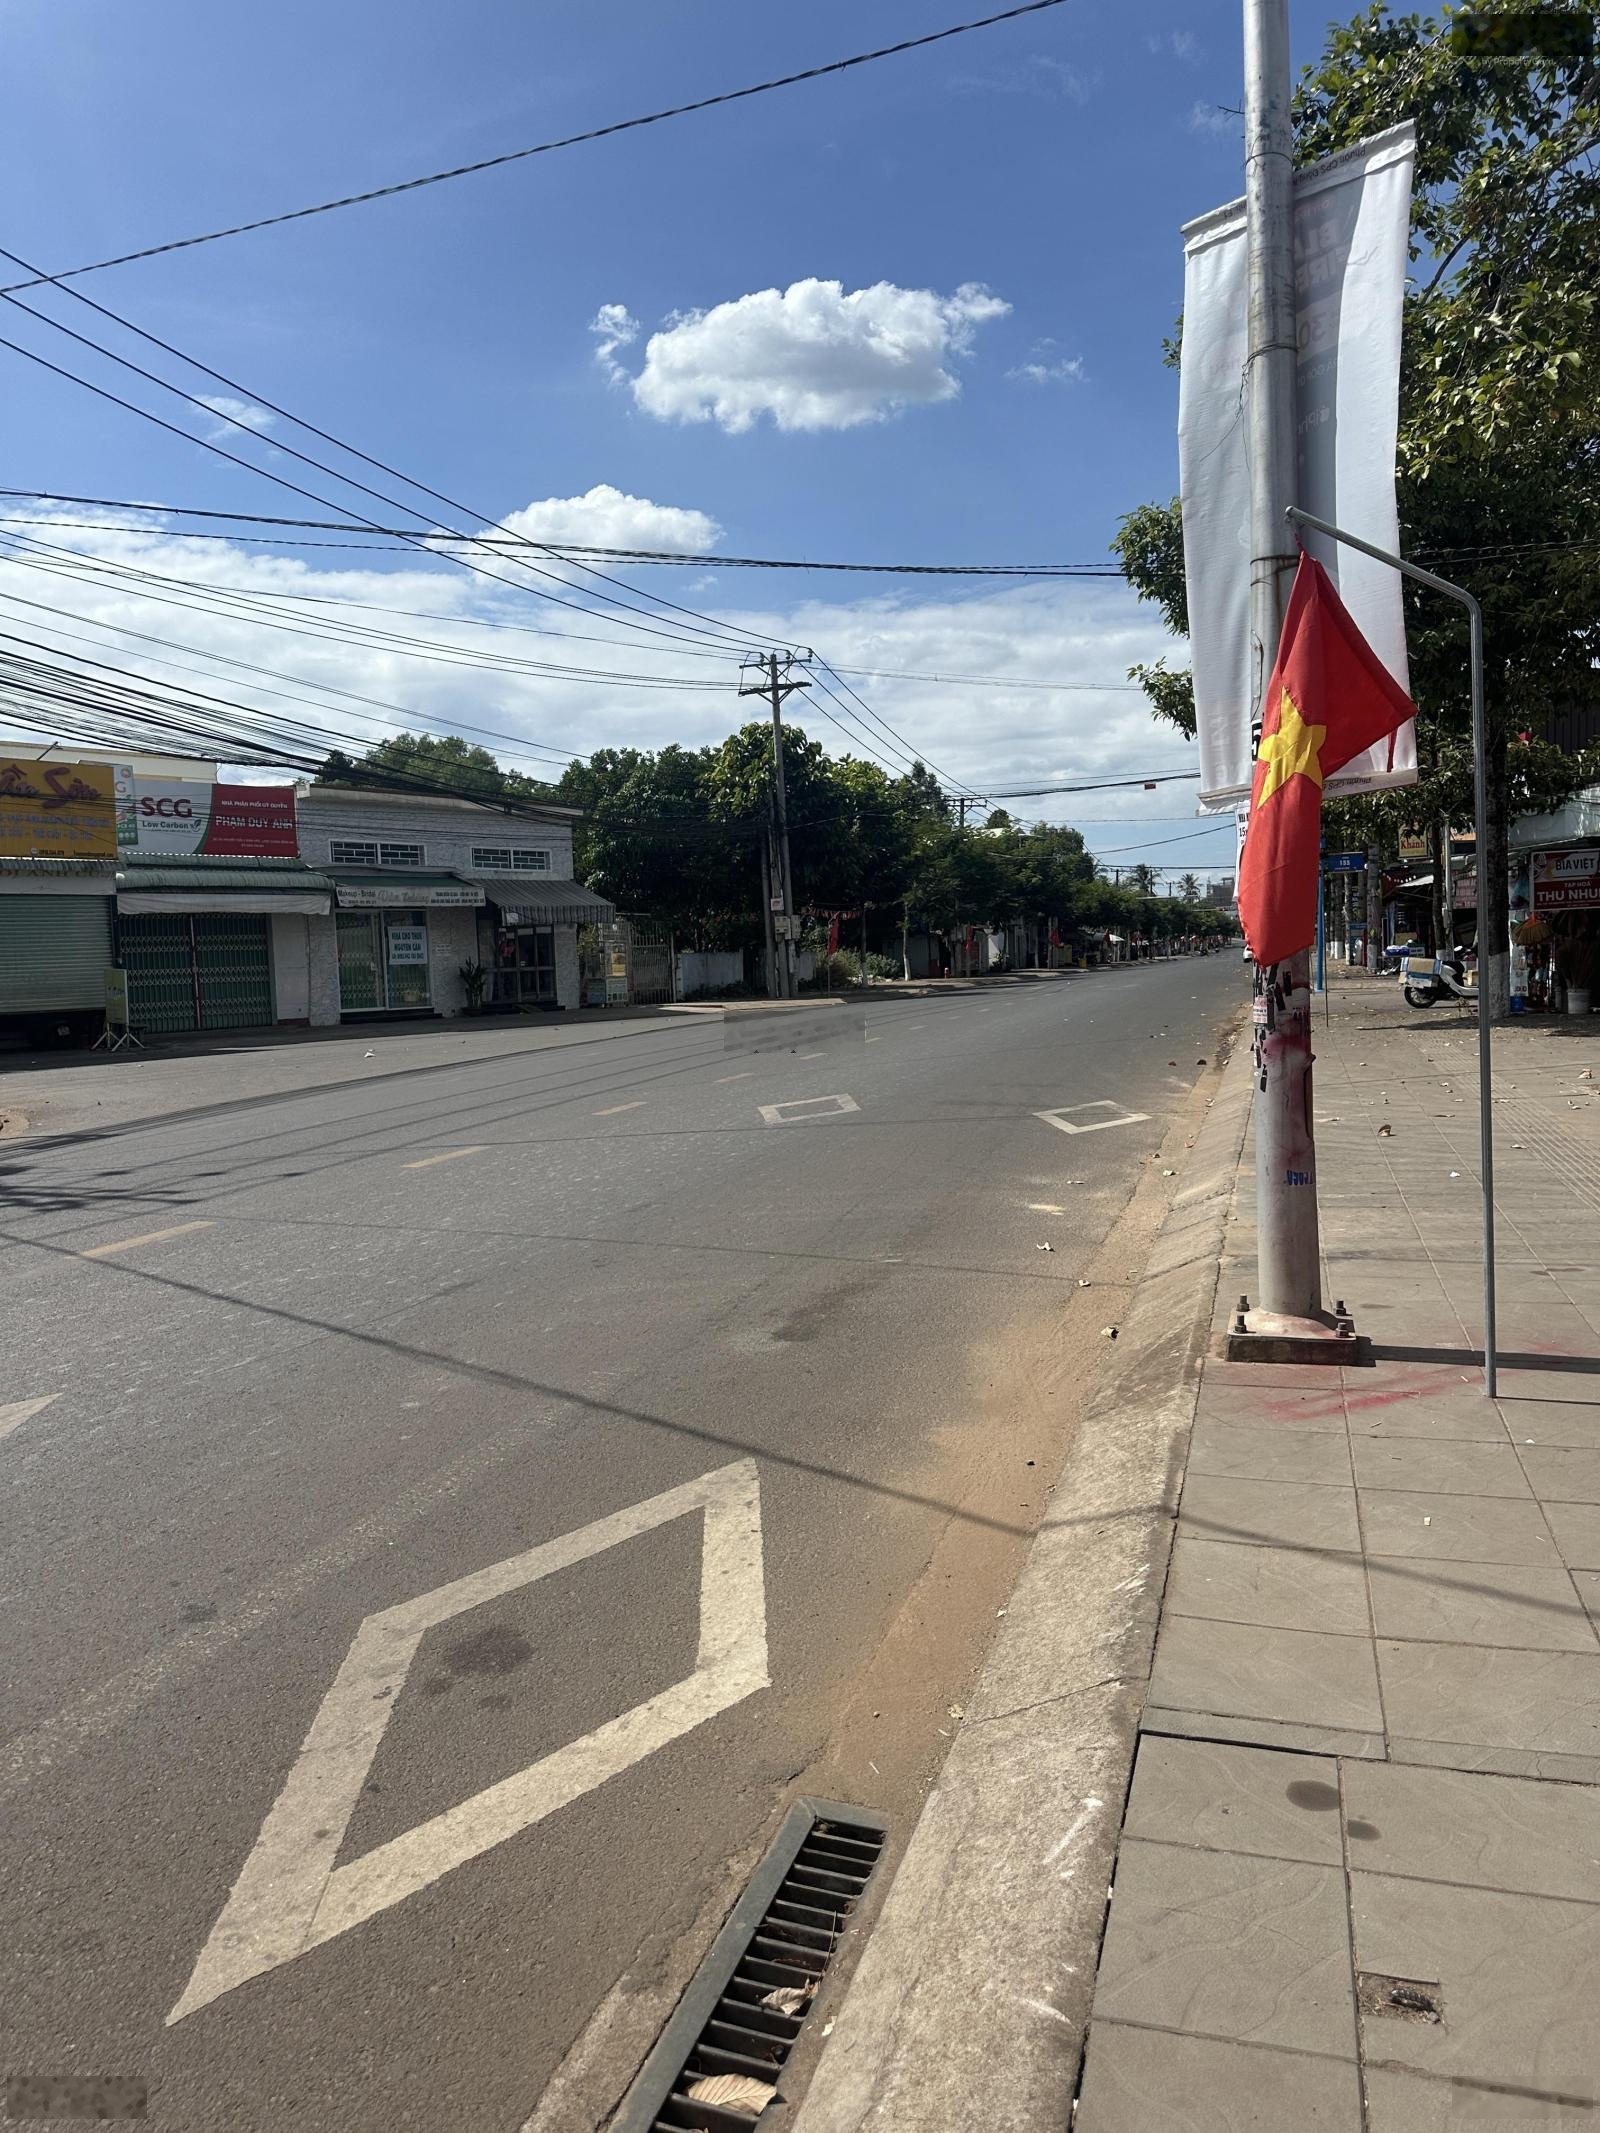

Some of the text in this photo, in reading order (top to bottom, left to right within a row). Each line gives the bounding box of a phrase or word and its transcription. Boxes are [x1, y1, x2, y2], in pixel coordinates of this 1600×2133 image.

[141, 796, 192, 817] SCG
[142, 820, 159, 828] Low
[160, 821, 189, 829] Carbon
[215, 816, 246, 830] PHẠM
[248, 817, 269, 828] DUY
[1556, 857, 1596, 870] BIA VIỆT
[1537, 887, 1600, 902] THU NHU
